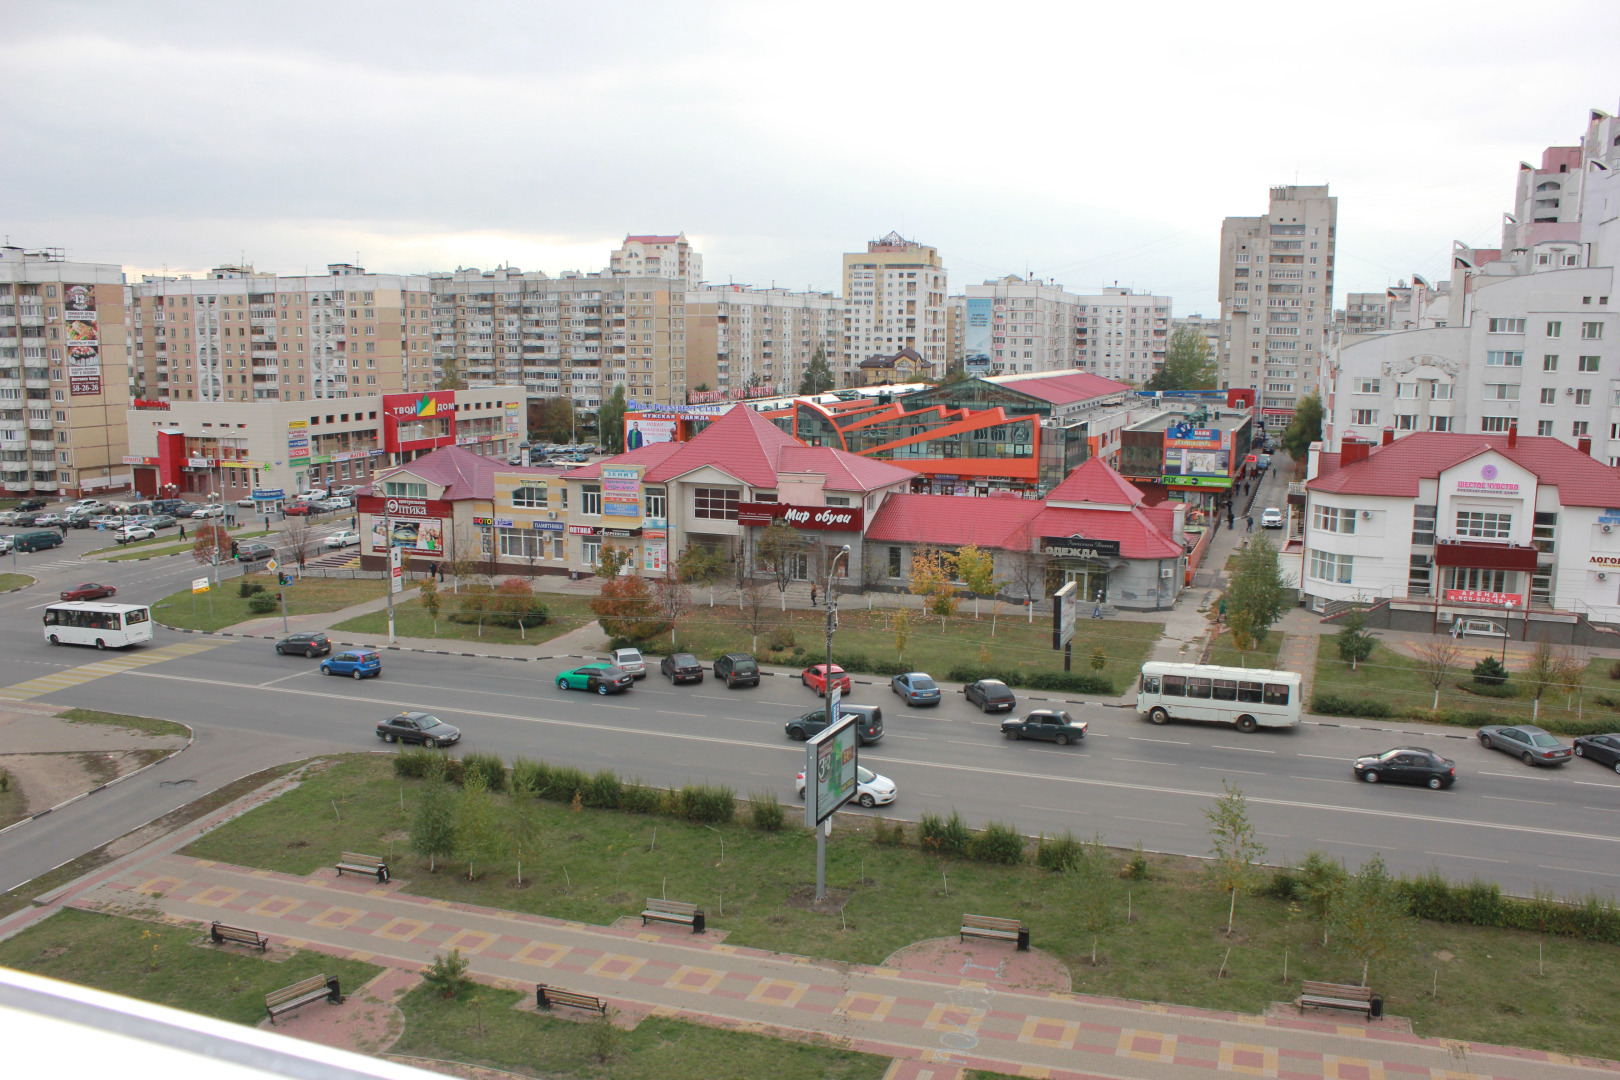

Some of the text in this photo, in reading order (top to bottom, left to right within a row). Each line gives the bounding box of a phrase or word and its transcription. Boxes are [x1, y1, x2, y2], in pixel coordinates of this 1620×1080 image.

[393, 403, 455, 415] ТВОЙ ДОМ
[654, 403, 697, 413] PRESIDENT
[699, 405, 721, 413] CLUB
[1163, 476, 1177, 484] FIX
[1457, 481, 1519, 490] ШЕСТОЕ ЧУВСТВО
[785, 504, 851, 525] Мир обуви
[534, 522, 563, 530] ПАМЯТНИКИ
[569, 526, 591, 534] ОПТИКА
[1045, 547, 1099, 559] ОДЕЖДА
[1461, 590, 1507, 599] АРЕНДА
